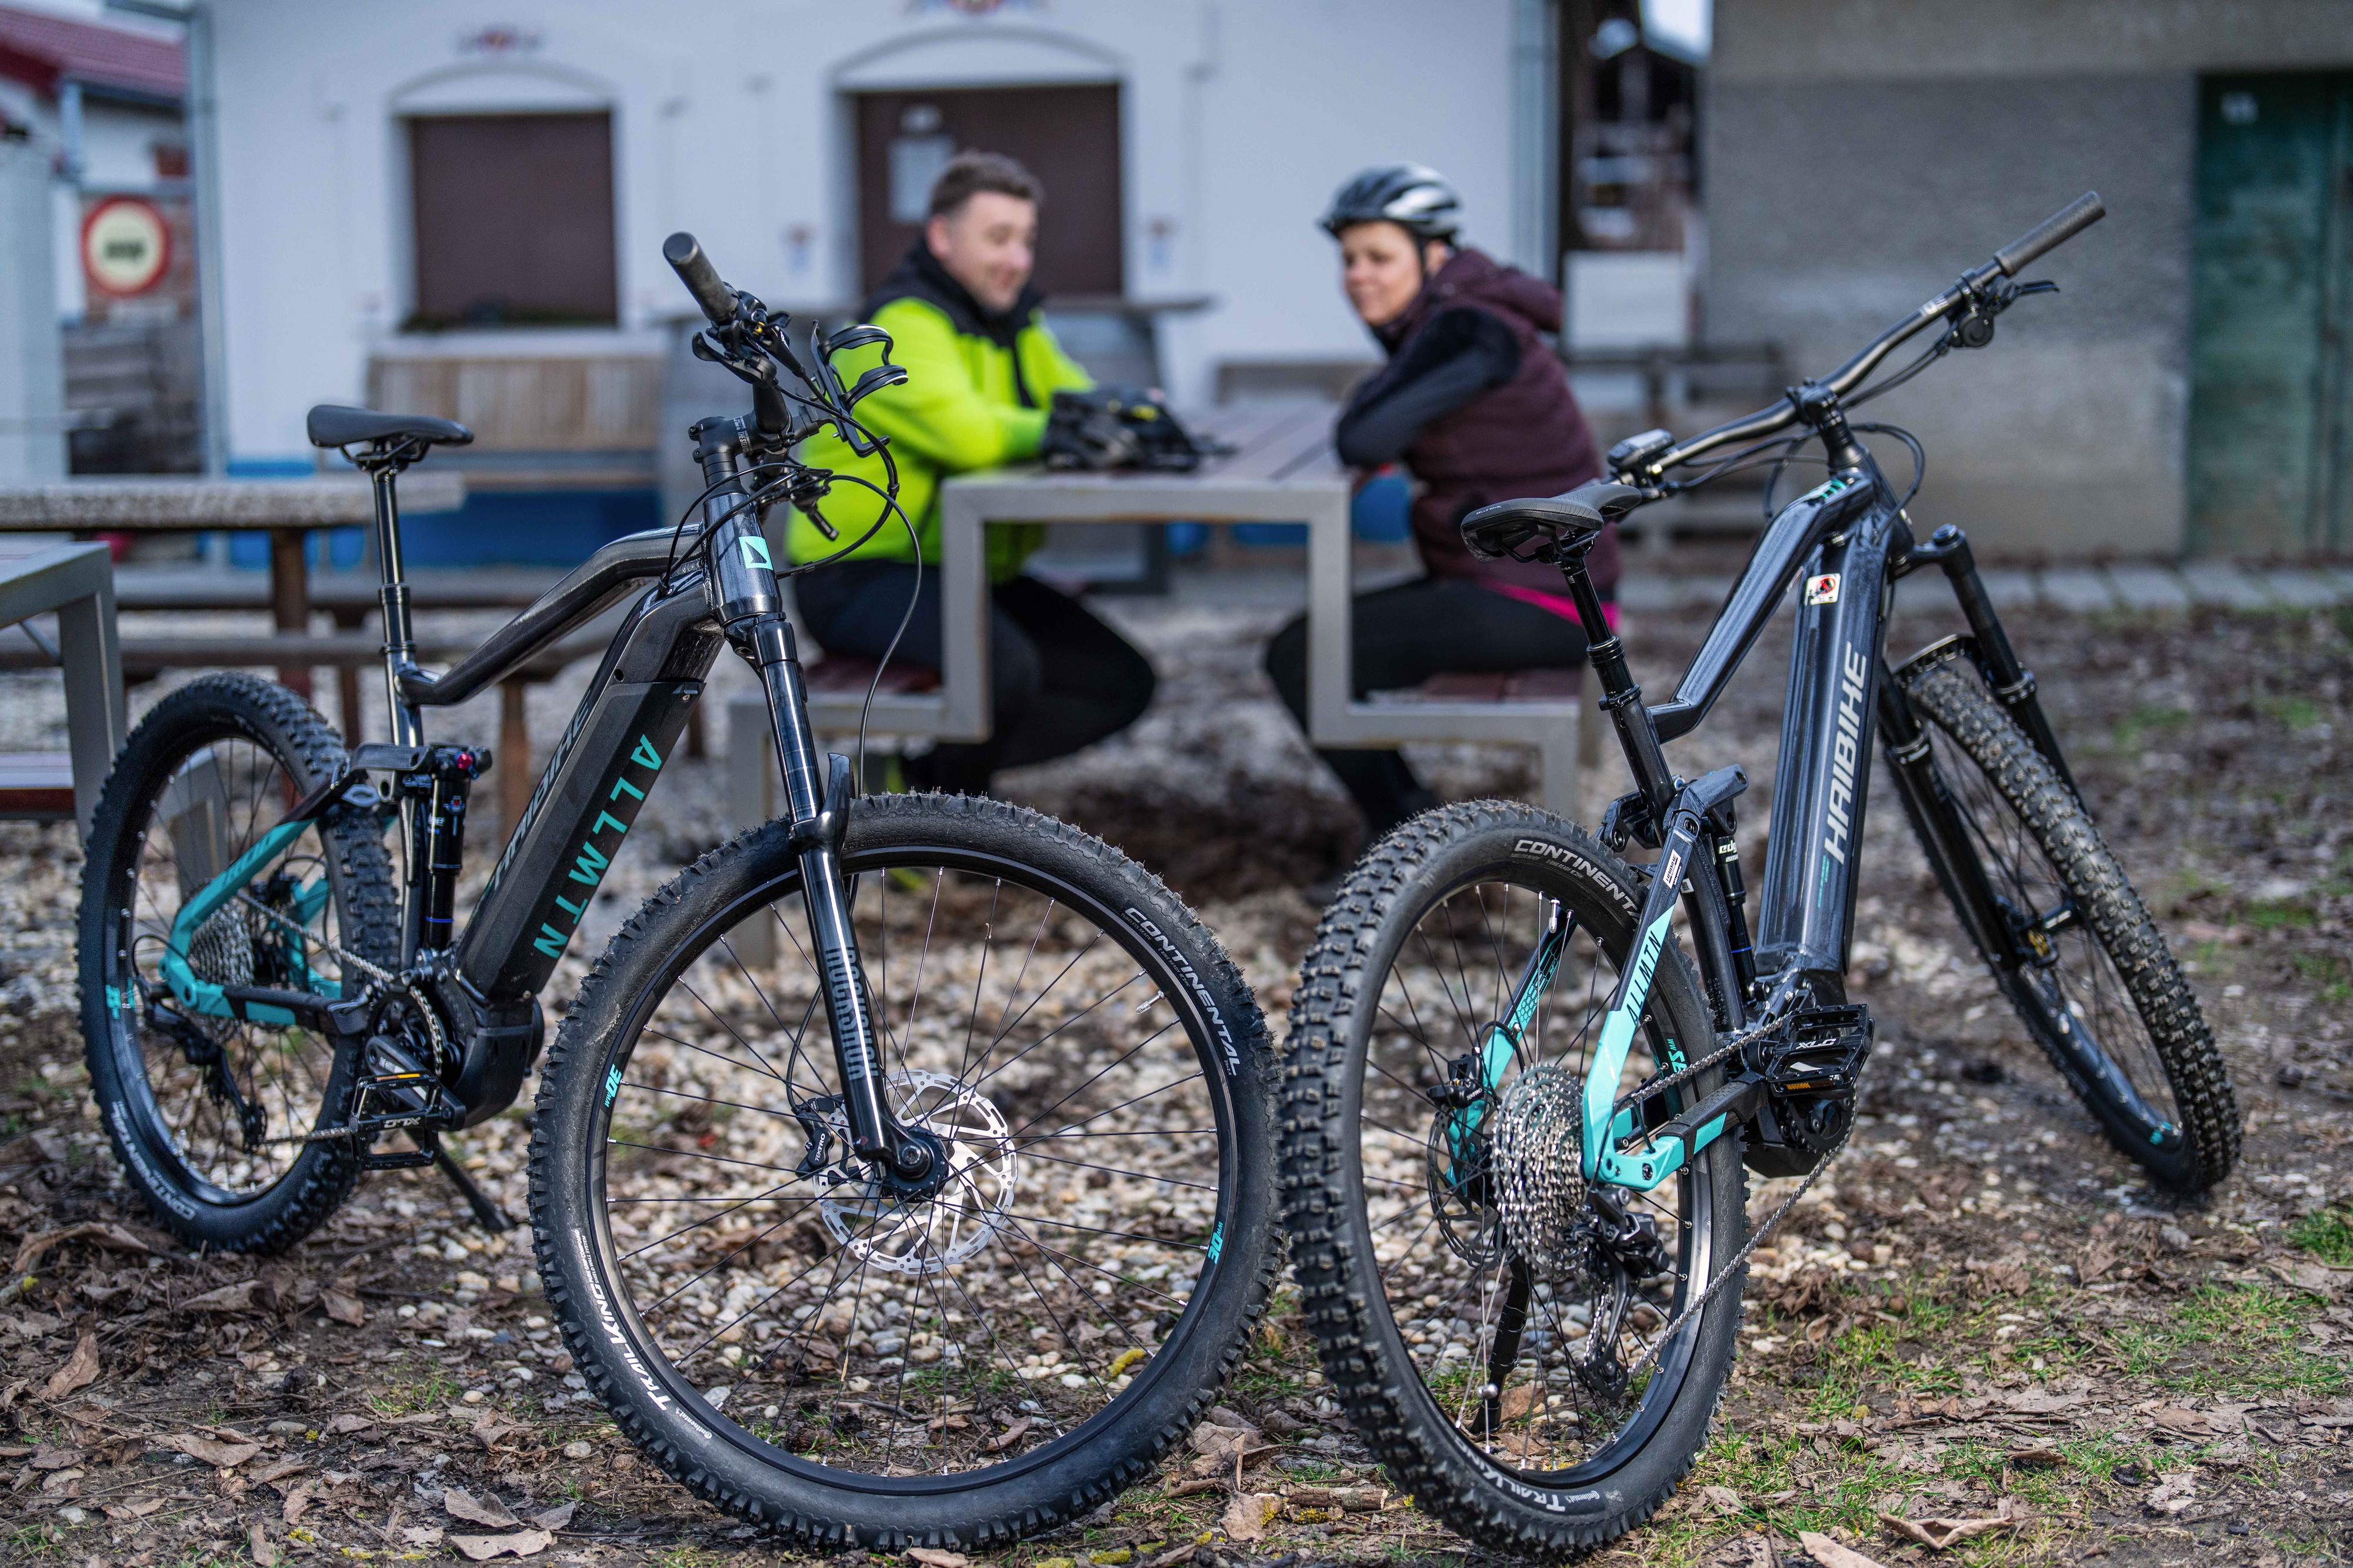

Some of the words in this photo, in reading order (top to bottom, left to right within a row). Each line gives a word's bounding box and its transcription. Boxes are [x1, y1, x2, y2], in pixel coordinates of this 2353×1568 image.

[1824, 641, 1867, 865] HAIBIKE
[534, 734, 662, 959] ALLMTN
[1666, 853, 1677, 881] HAIBIKE
[1138, 928, 1152, 939] READY
[1168, 960, 1181, 972] READY
[1627, 930, 1662, 1025] ALLMTN
[1124, 907, 1241, 1076] CONTINENTAL
[1795, 1038, 1837, 1050] XLC
[574, 1230, 585, 1258] COMPOUND
[581, 1235, 590, 1253] SYSTEM
[585, 1270, 594, 1283] PURE
[589, 1267, 599, 1283] SHIELD
[590, 1283, 627, 1343] KING
[624, 1343, 671, 1410] TRAIL
[1503, 1477, 1566, 1512] TRAIL
